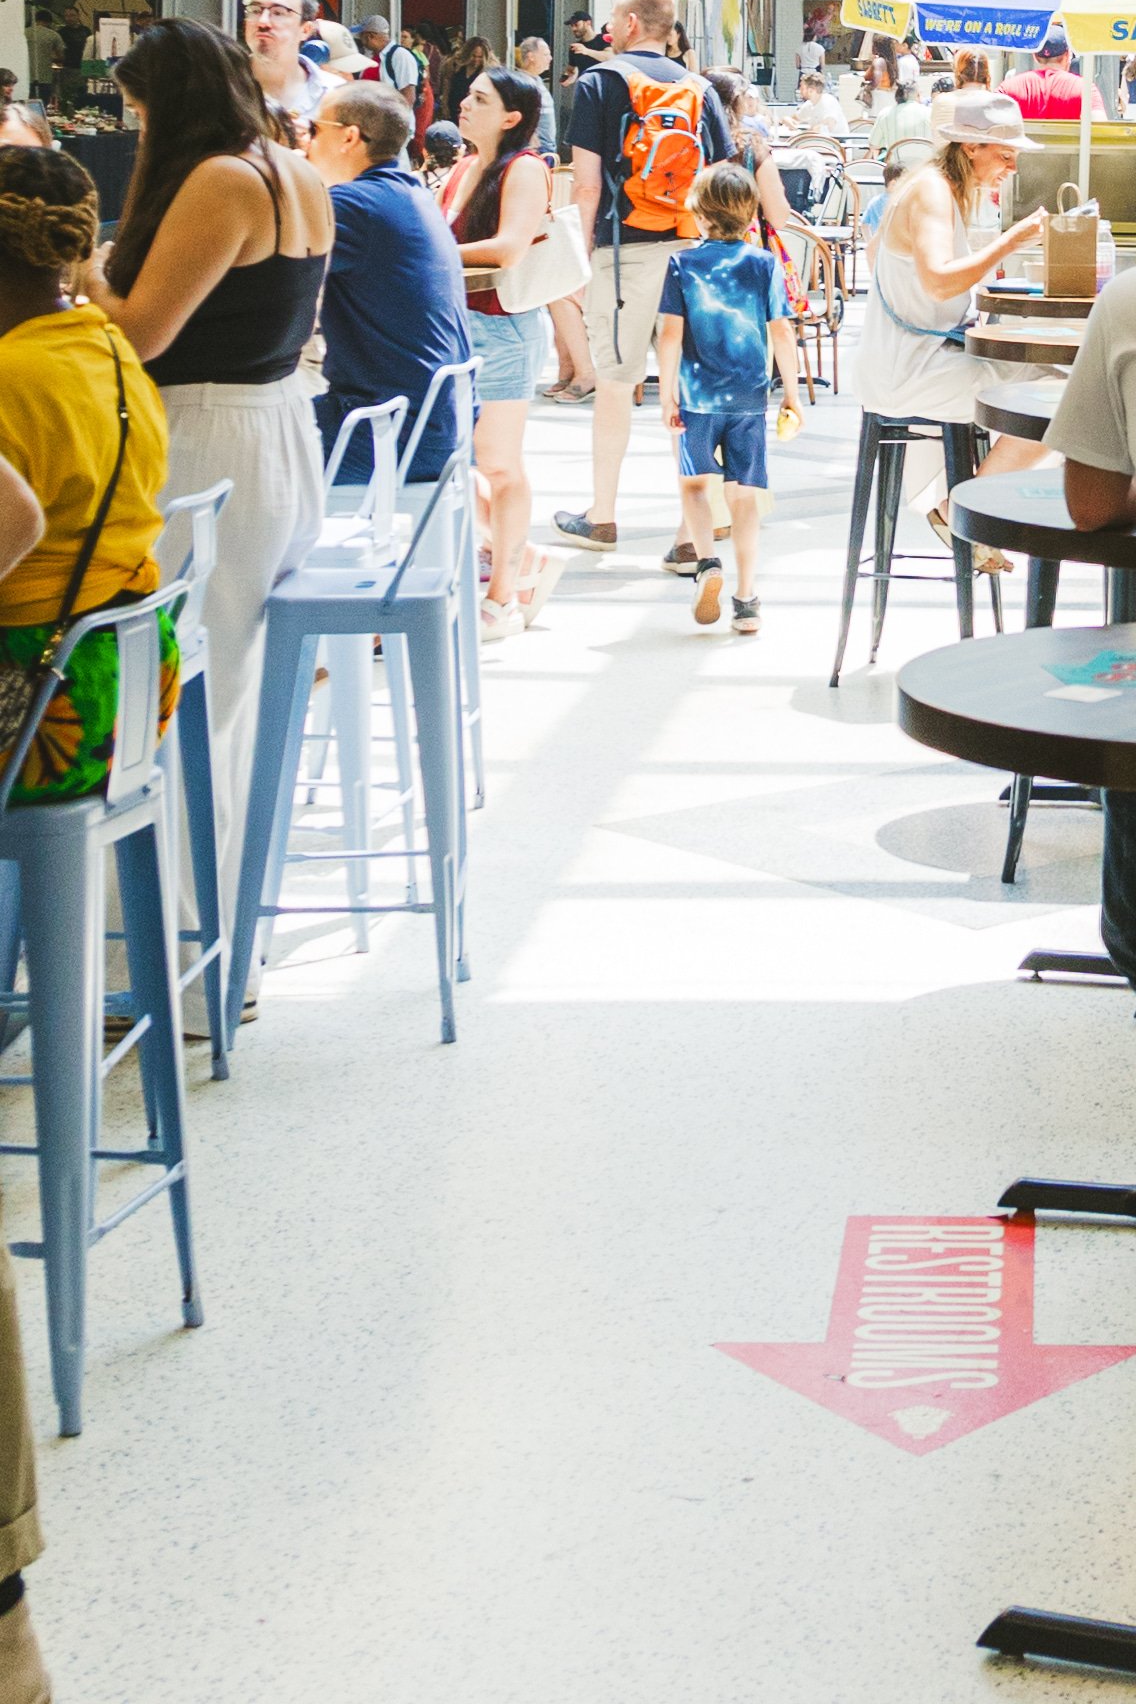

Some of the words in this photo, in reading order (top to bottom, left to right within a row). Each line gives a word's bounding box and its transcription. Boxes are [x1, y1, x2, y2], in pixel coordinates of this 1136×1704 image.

[925, 18, 963, 33] WE'RE
[964, 20, 982, 33] ON
[984, 21, 993, 34] A
[995, 22, 1022, 37] ROLL
[847, 1224, 1006, 1390] RESTROOMS
